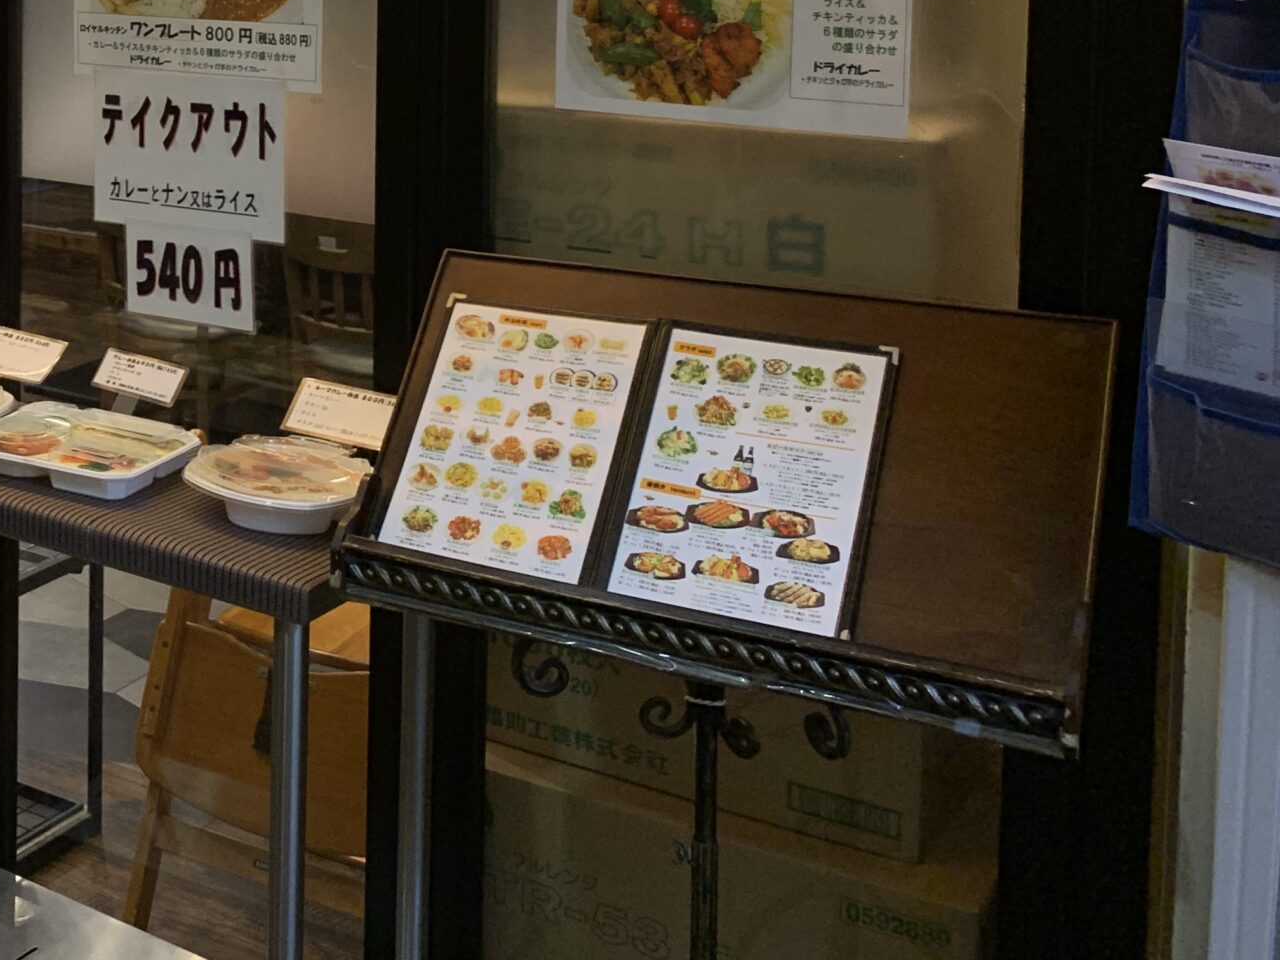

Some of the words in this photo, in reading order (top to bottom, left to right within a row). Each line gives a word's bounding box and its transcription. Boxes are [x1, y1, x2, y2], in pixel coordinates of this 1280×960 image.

[80, 24, 128, 35] ロイヤルキッチン
[129, 22, 202, 40] ワンプレート
[130, 54, 173, 66] ドライカレー
[814, 61, 881, 76] ドライカレー
[102, 94, 277, 160] テイクアウト
[110, 177, 259, 215] カレーとナン又はライス
